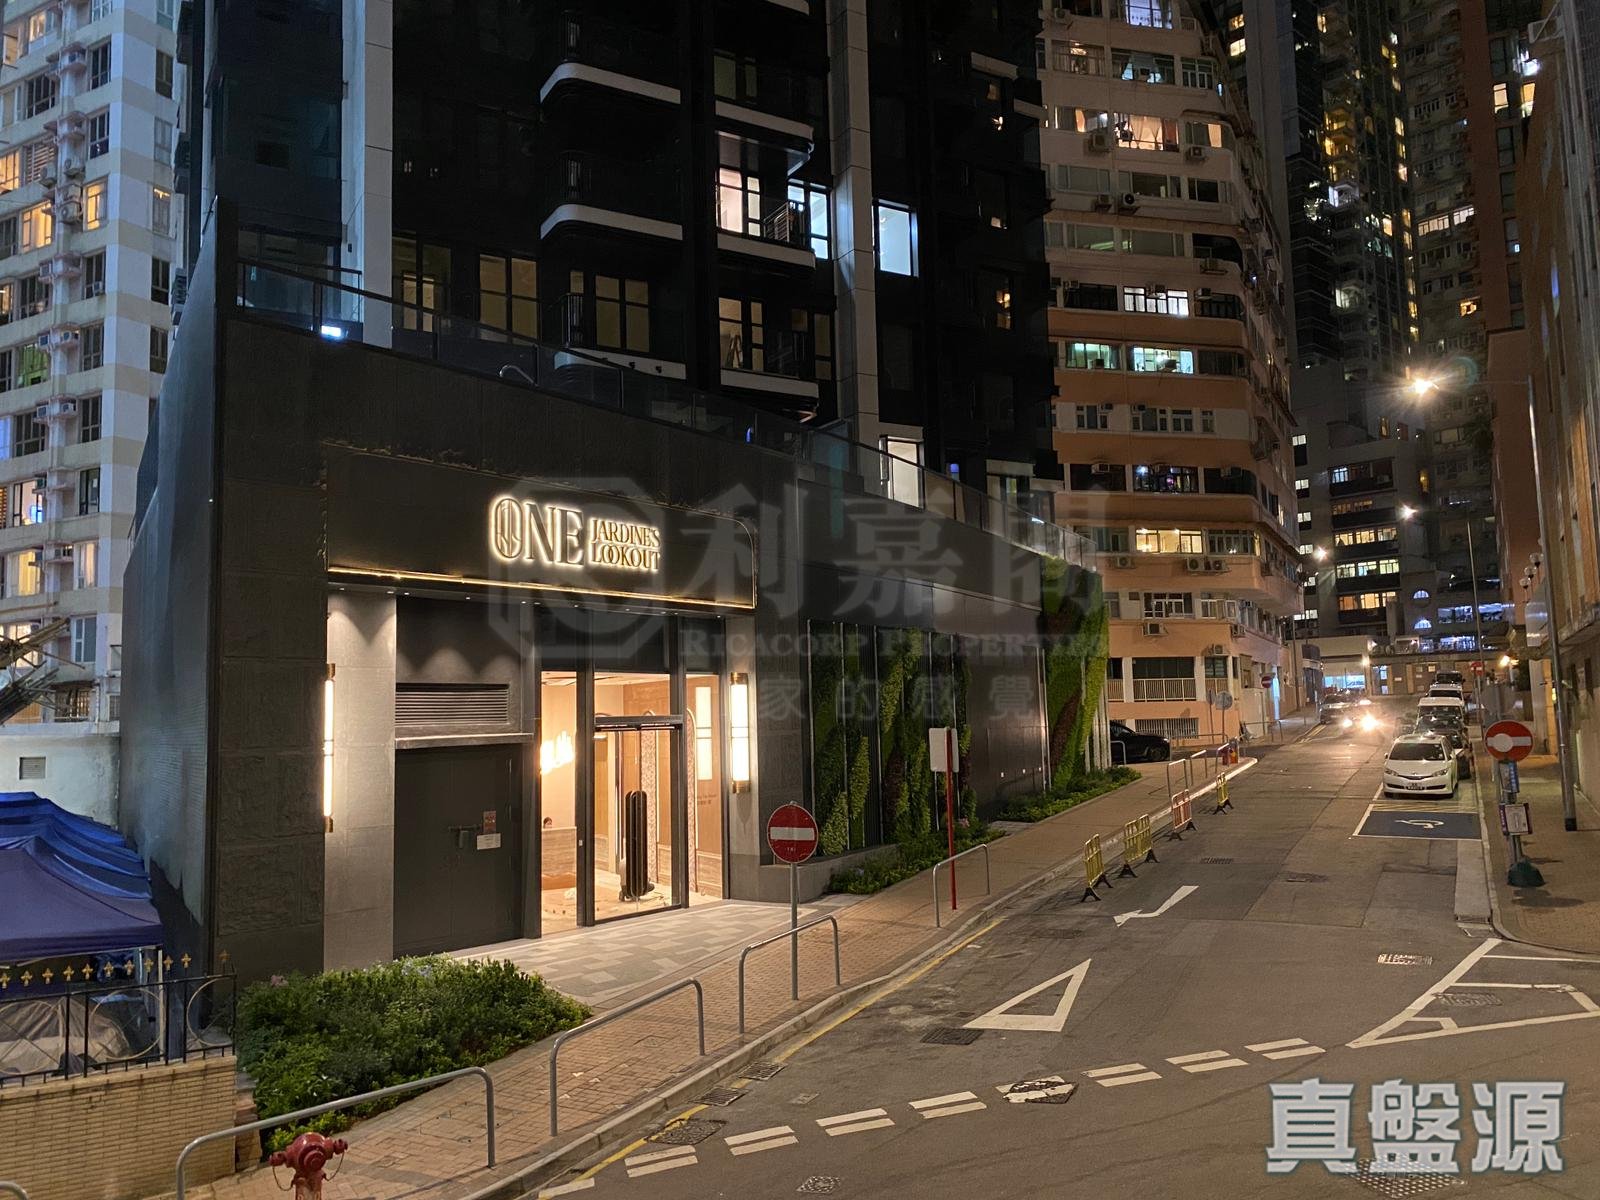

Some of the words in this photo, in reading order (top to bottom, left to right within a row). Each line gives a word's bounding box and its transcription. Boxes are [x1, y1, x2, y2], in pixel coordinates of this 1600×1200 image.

[493, 498, 585, 567] ONE
[592, 519, 661, 548] JARDINE'S
[592, 542, 661, 570] LOOKOUT
